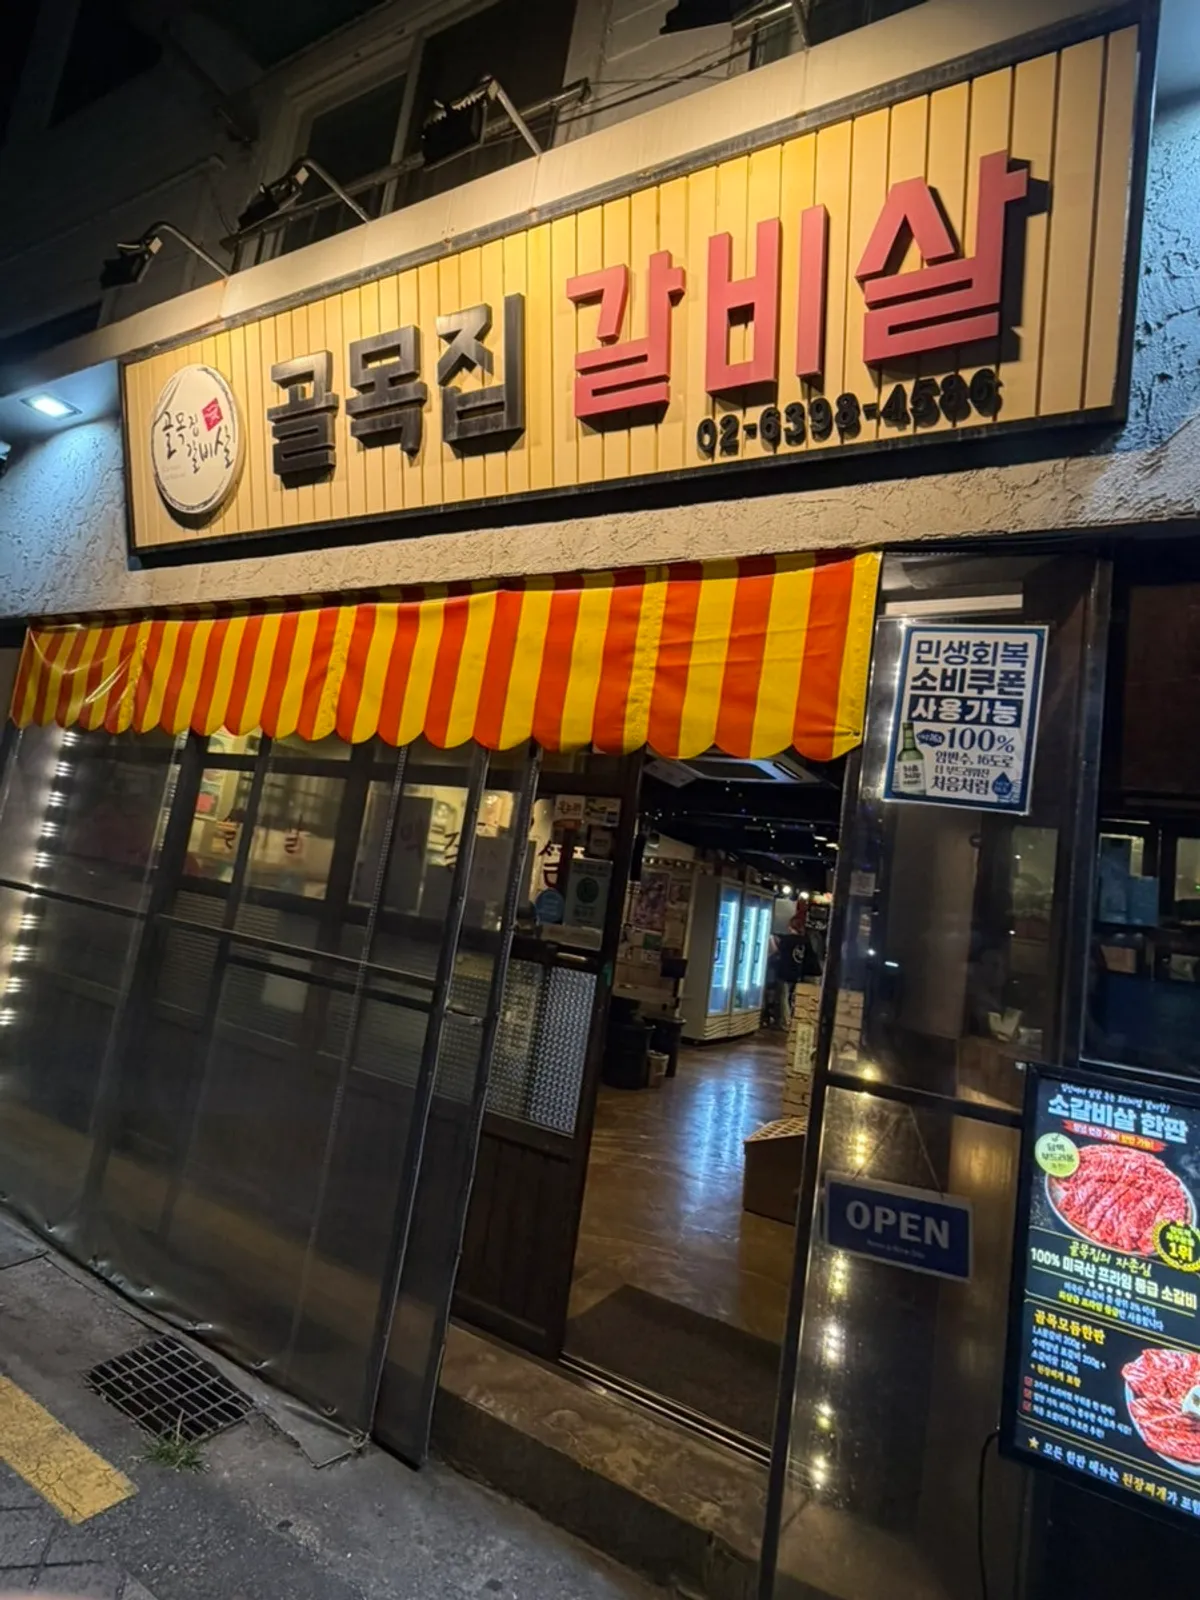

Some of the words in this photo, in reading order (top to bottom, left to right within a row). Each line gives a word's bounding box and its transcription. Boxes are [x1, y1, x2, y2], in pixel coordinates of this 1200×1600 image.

[267, 293, 526, 486] 골목집
[566, 150, 1028, 420] 갈비살
[162, 411, 199, 459] 골목집
[696, 368, 1003, 459] 02-6398-4586
[187, 426, 233, 474] 갈비살
[915, 640, 1029, 668] 민생회복
[910, 668, 1026, 696] 소비쿠폰
[911, 698, 1018, 725] 사용가능
[948, 727, 1015, 753] 100%
[931, 775, 990, 795] 처음처럼
[1048, 1094, 1137, 1132] 소갈비살
[1141, 1112, 1189, 1144] 한판
[846, 1200, 949, 1249] OPEN
[1031, 1247, 1060, 1268] 100%
[1062, 1257, 1096, 1279] 미국산
[1098, 1266, 1132, 1291] 프라임
[1135, 1276, 1158, 1298] 등급
[1069, 1241, 1111, 1264] 골목집의
[1116, 1256, 1152, 1277] 자존심
[1169, 1243, 1193, 1263] 1위
[1043, 1442, 1063, 1460] 모든
[1089, 1460, 1119, 1482] 메뉴는
[1121, 1472, 1178, 1505] 된장찌개가
